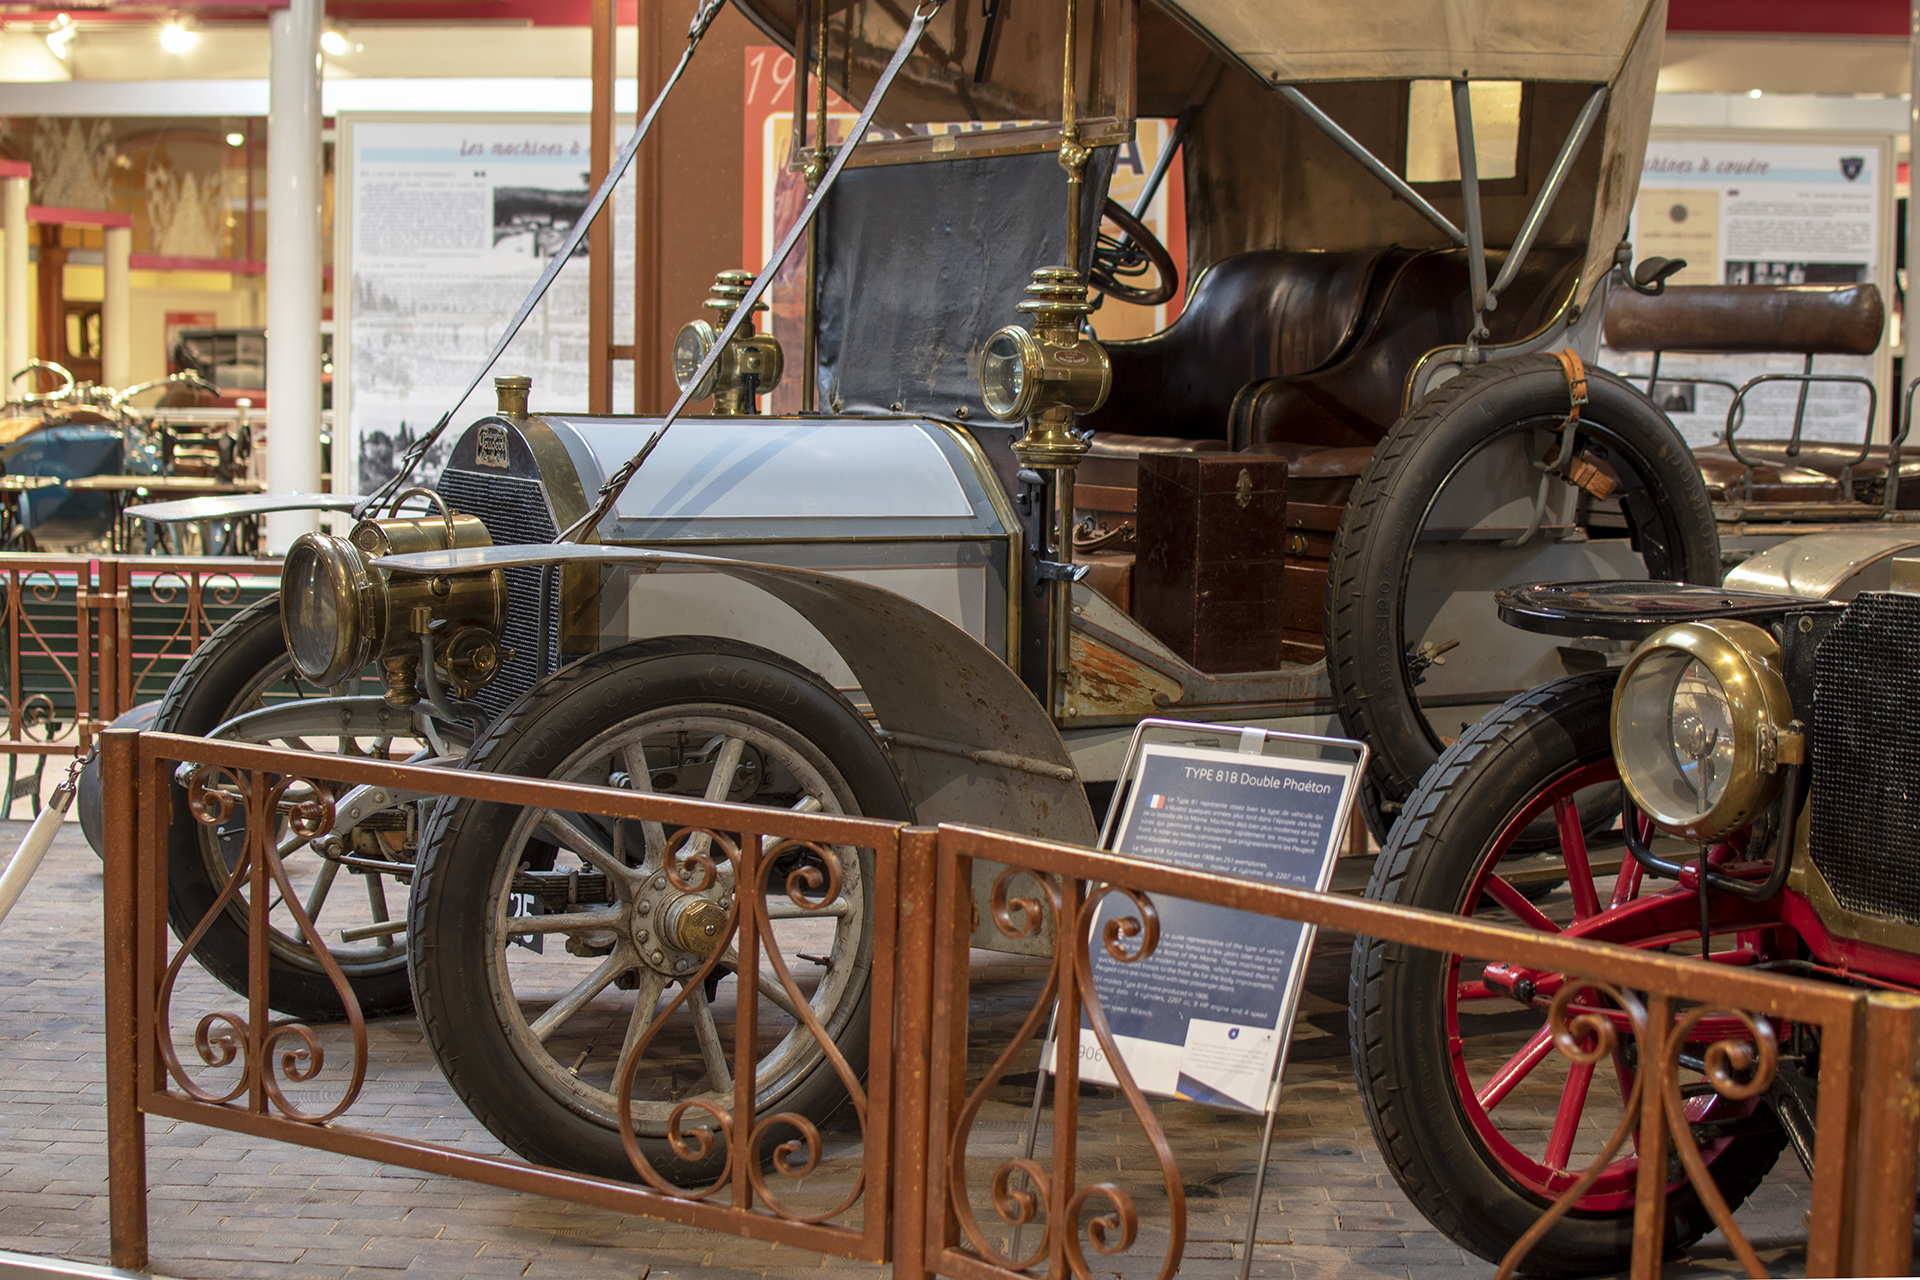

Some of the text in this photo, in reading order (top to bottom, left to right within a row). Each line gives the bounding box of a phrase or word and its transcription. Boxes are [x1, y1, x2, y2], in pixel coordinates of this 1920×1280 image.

[460, 140, 484, 157] Les
[491, 141, 563, 156] machines
[570, 140, 580, 156] à
[1642, 157, 1770, 175] chines à coudre
[708, 664, 806, 708] CORD
[1184, 765, 1331, 794] TYPE 81B Double Phaéton
[690, 933, 717, 952] PEUGEO
[1076, 1044, 1104, 1062] 906
